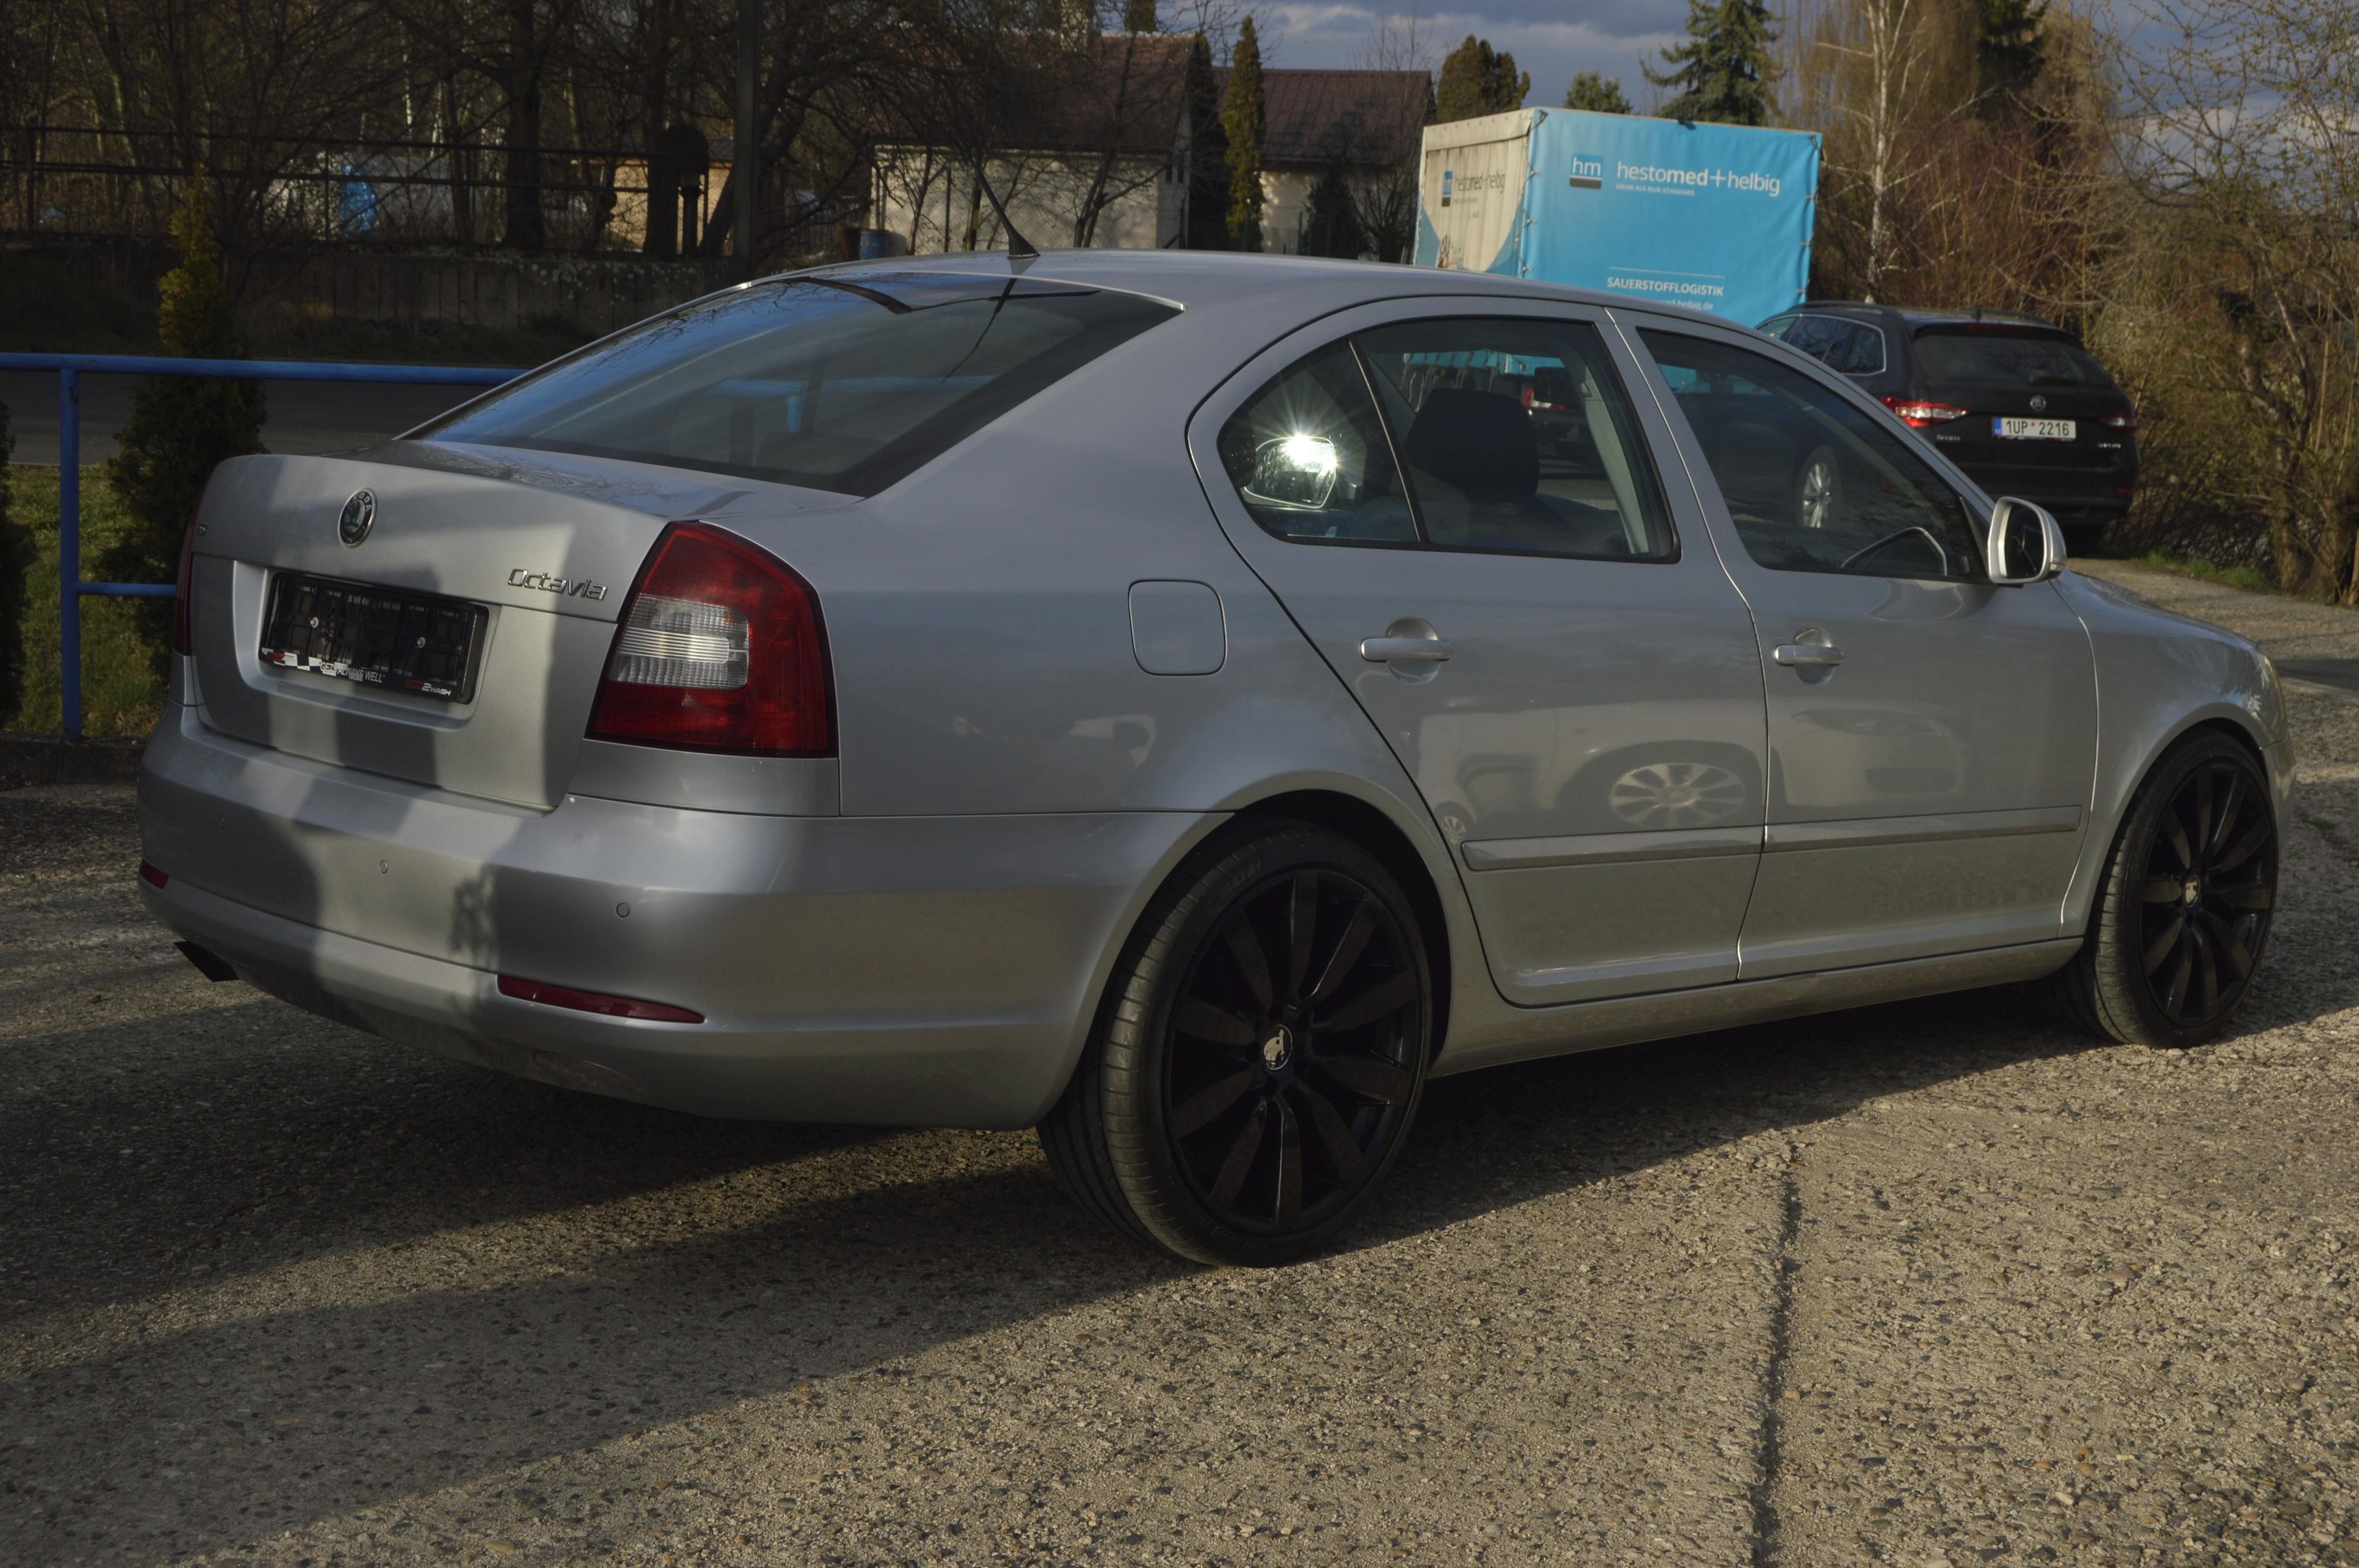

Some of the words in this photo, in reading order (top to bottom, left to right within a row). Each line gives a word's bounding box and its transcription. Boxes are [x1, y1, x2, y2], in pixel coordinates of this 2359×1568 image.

[1572, 156, 1601, 176] hm
[1662, 187, 1695, 196] STANDARD
[1607, 276, 1724, 297] SAUERSTOFFLOGISTIK
[2006, 420, 2028, 434] 1UP
[2039, 422, 2069, 436] 2216
[507, 568, 608, 601] Octavia
